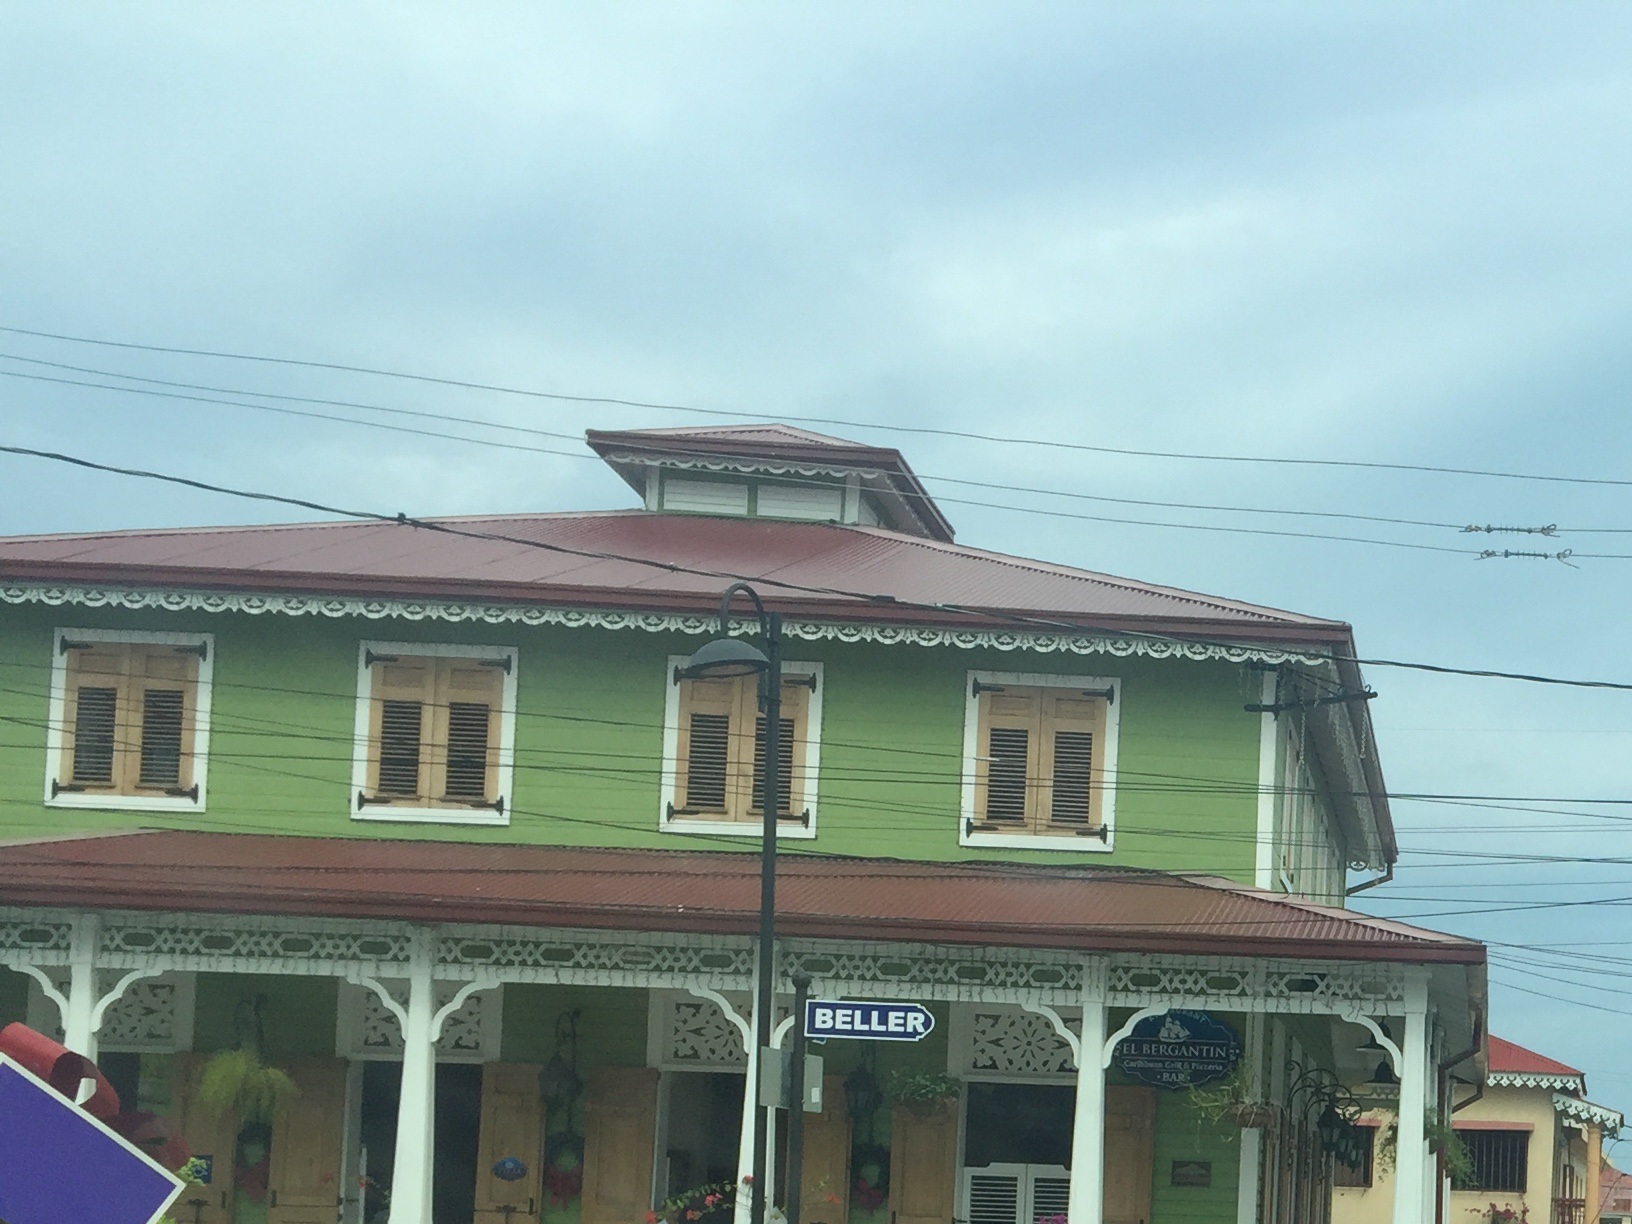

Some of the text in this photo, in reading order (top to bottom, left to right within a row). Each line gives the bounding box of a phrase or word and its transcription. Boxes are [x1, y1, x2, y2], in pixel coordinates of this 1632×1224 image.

[814, 1008, 925, 1033] BELLER
[1123, 1043, 1139, 1054] EL
[1142, 1043, 1227, 1058] BERGANTIN
[1165, 1061, 1183, 1070] Grill
[1192, 1061, 1223, 1071] Pizzeria
[1162, 1072, 1185, 1082] BAR
